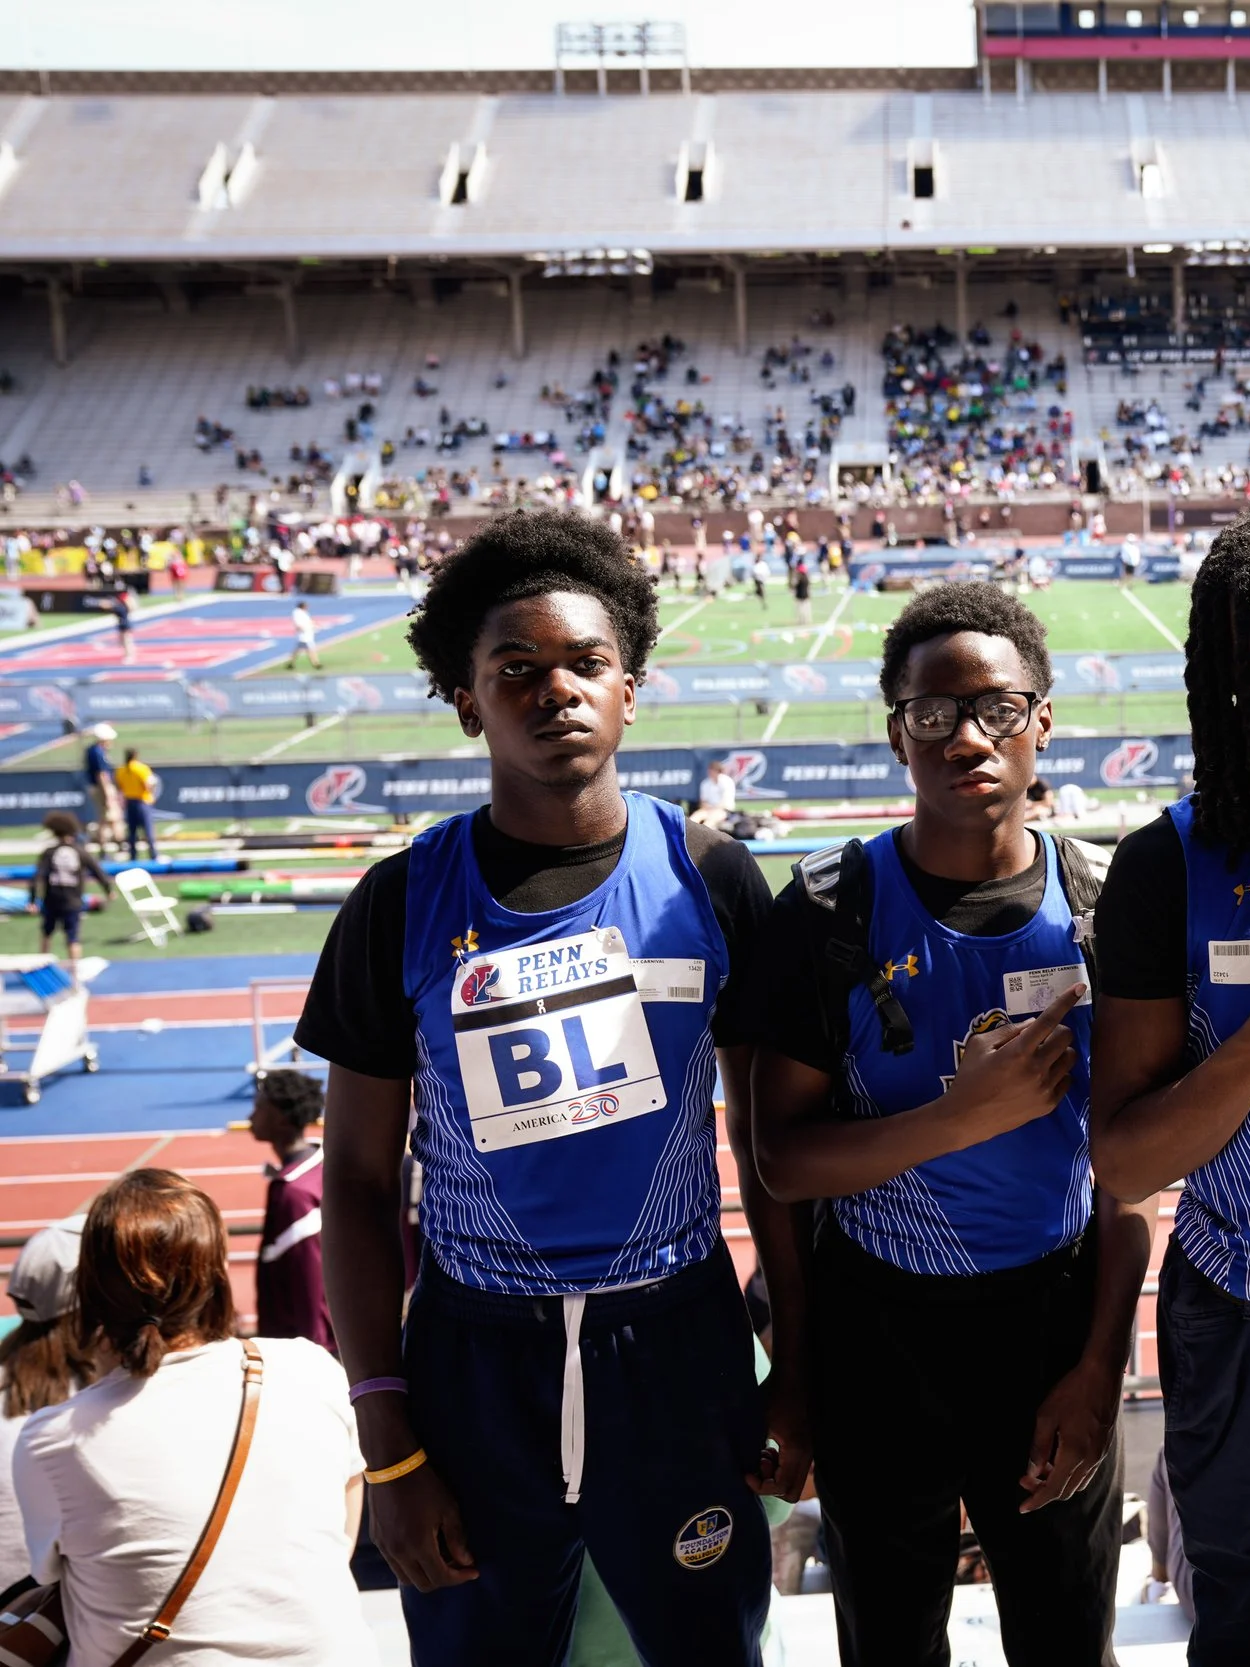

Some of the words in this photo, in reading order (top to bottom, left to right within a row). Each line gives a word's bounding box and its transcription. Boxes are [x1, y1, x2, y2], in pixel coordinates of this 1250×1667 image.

[517, 944, 584, 974] PENN
[518, 958, 608, 994] RELAYS
[487, 1015, 628, 1107] BL
[513, 1113, 568, 1132] AMERICA
[568, 1093, 620, 1125] 250
[680, 1529, 729, 1550] FOUNDATION
[684, 1538, 724, 1554] ACADEMY
